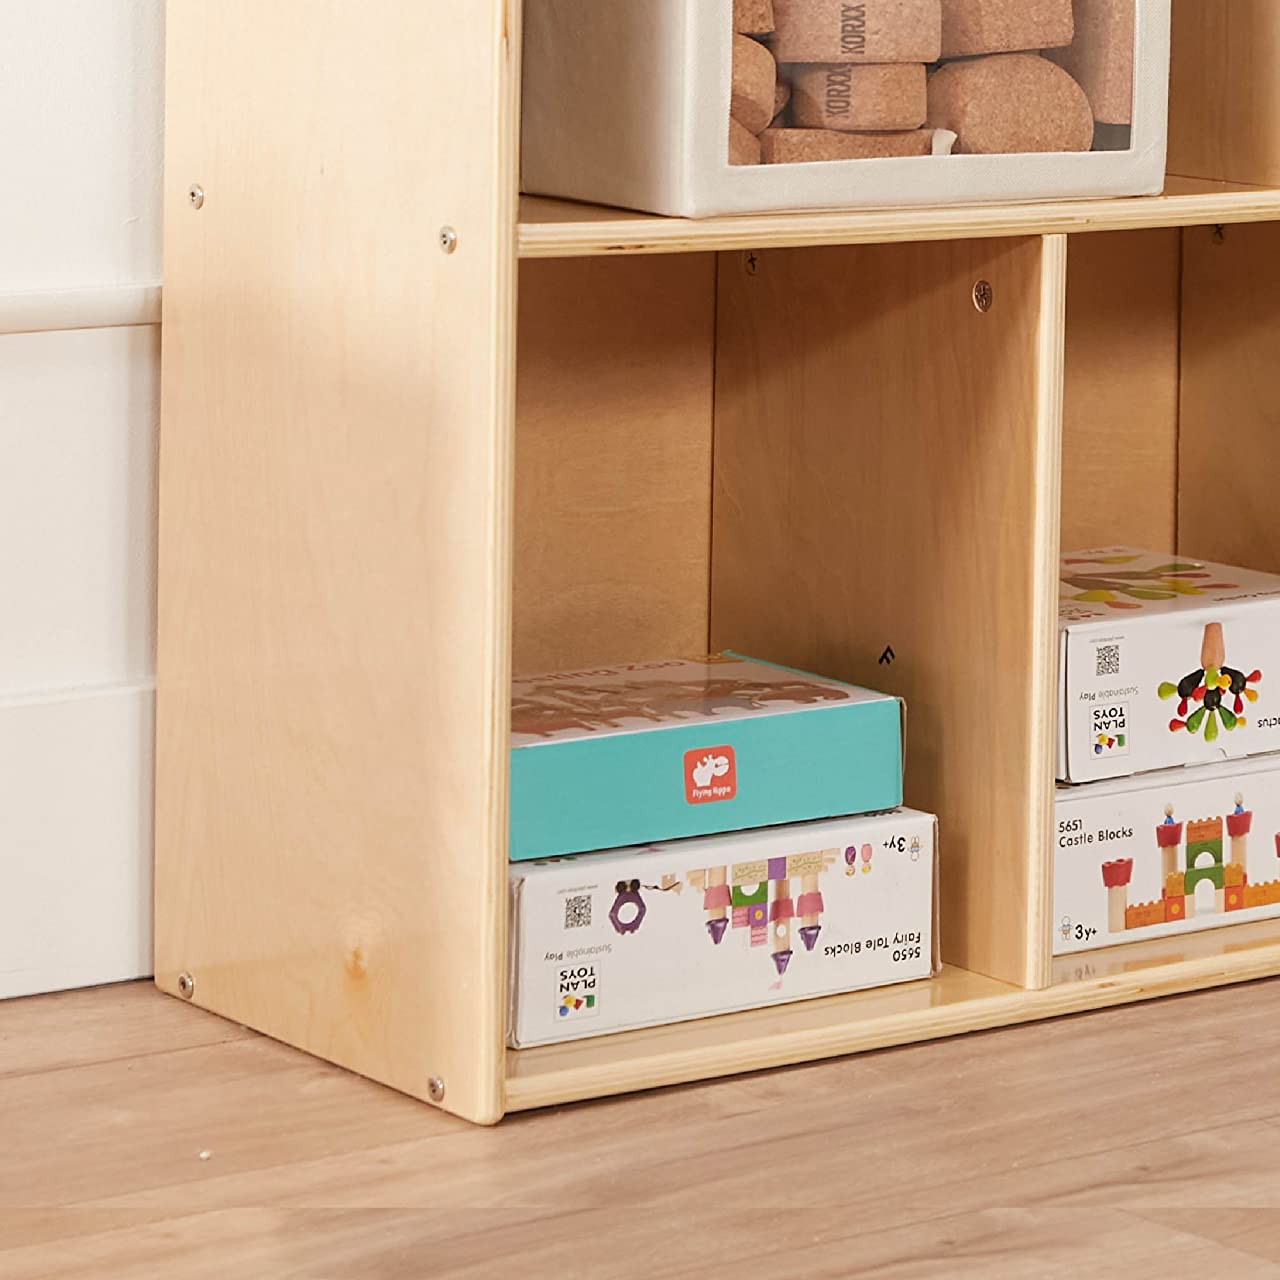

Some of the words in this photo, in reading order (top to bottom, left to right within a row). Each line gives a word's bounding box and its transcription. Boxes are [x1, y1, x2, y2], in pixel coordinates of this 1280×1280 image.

[841, 3, 866, 55] KORXX
[1079, 691, 1096, 701] Play
[1093, 707, 1125, 720] TOYS
[1093, 718, 1125, 731] PLAN
[1058, 819, 1082, 833] 5651
[883, 835, 906, 852] 3y+
[1059, 833, 1093, 848] Castle
[1098, 827, 1133, 841] Blocks
[893, 932, 921, 945] Fairy
[1075, 924, 1097, 941] 3y+
[824, 942, 861, 957] Blocks
[866, 937, 889, 951] Tale
[544, 951, 563, 960] Play
[893, 947, 921, 962] 5650
[560, 966, 595, 981] TOYS
[560, 978, 596, 992] PLAN
